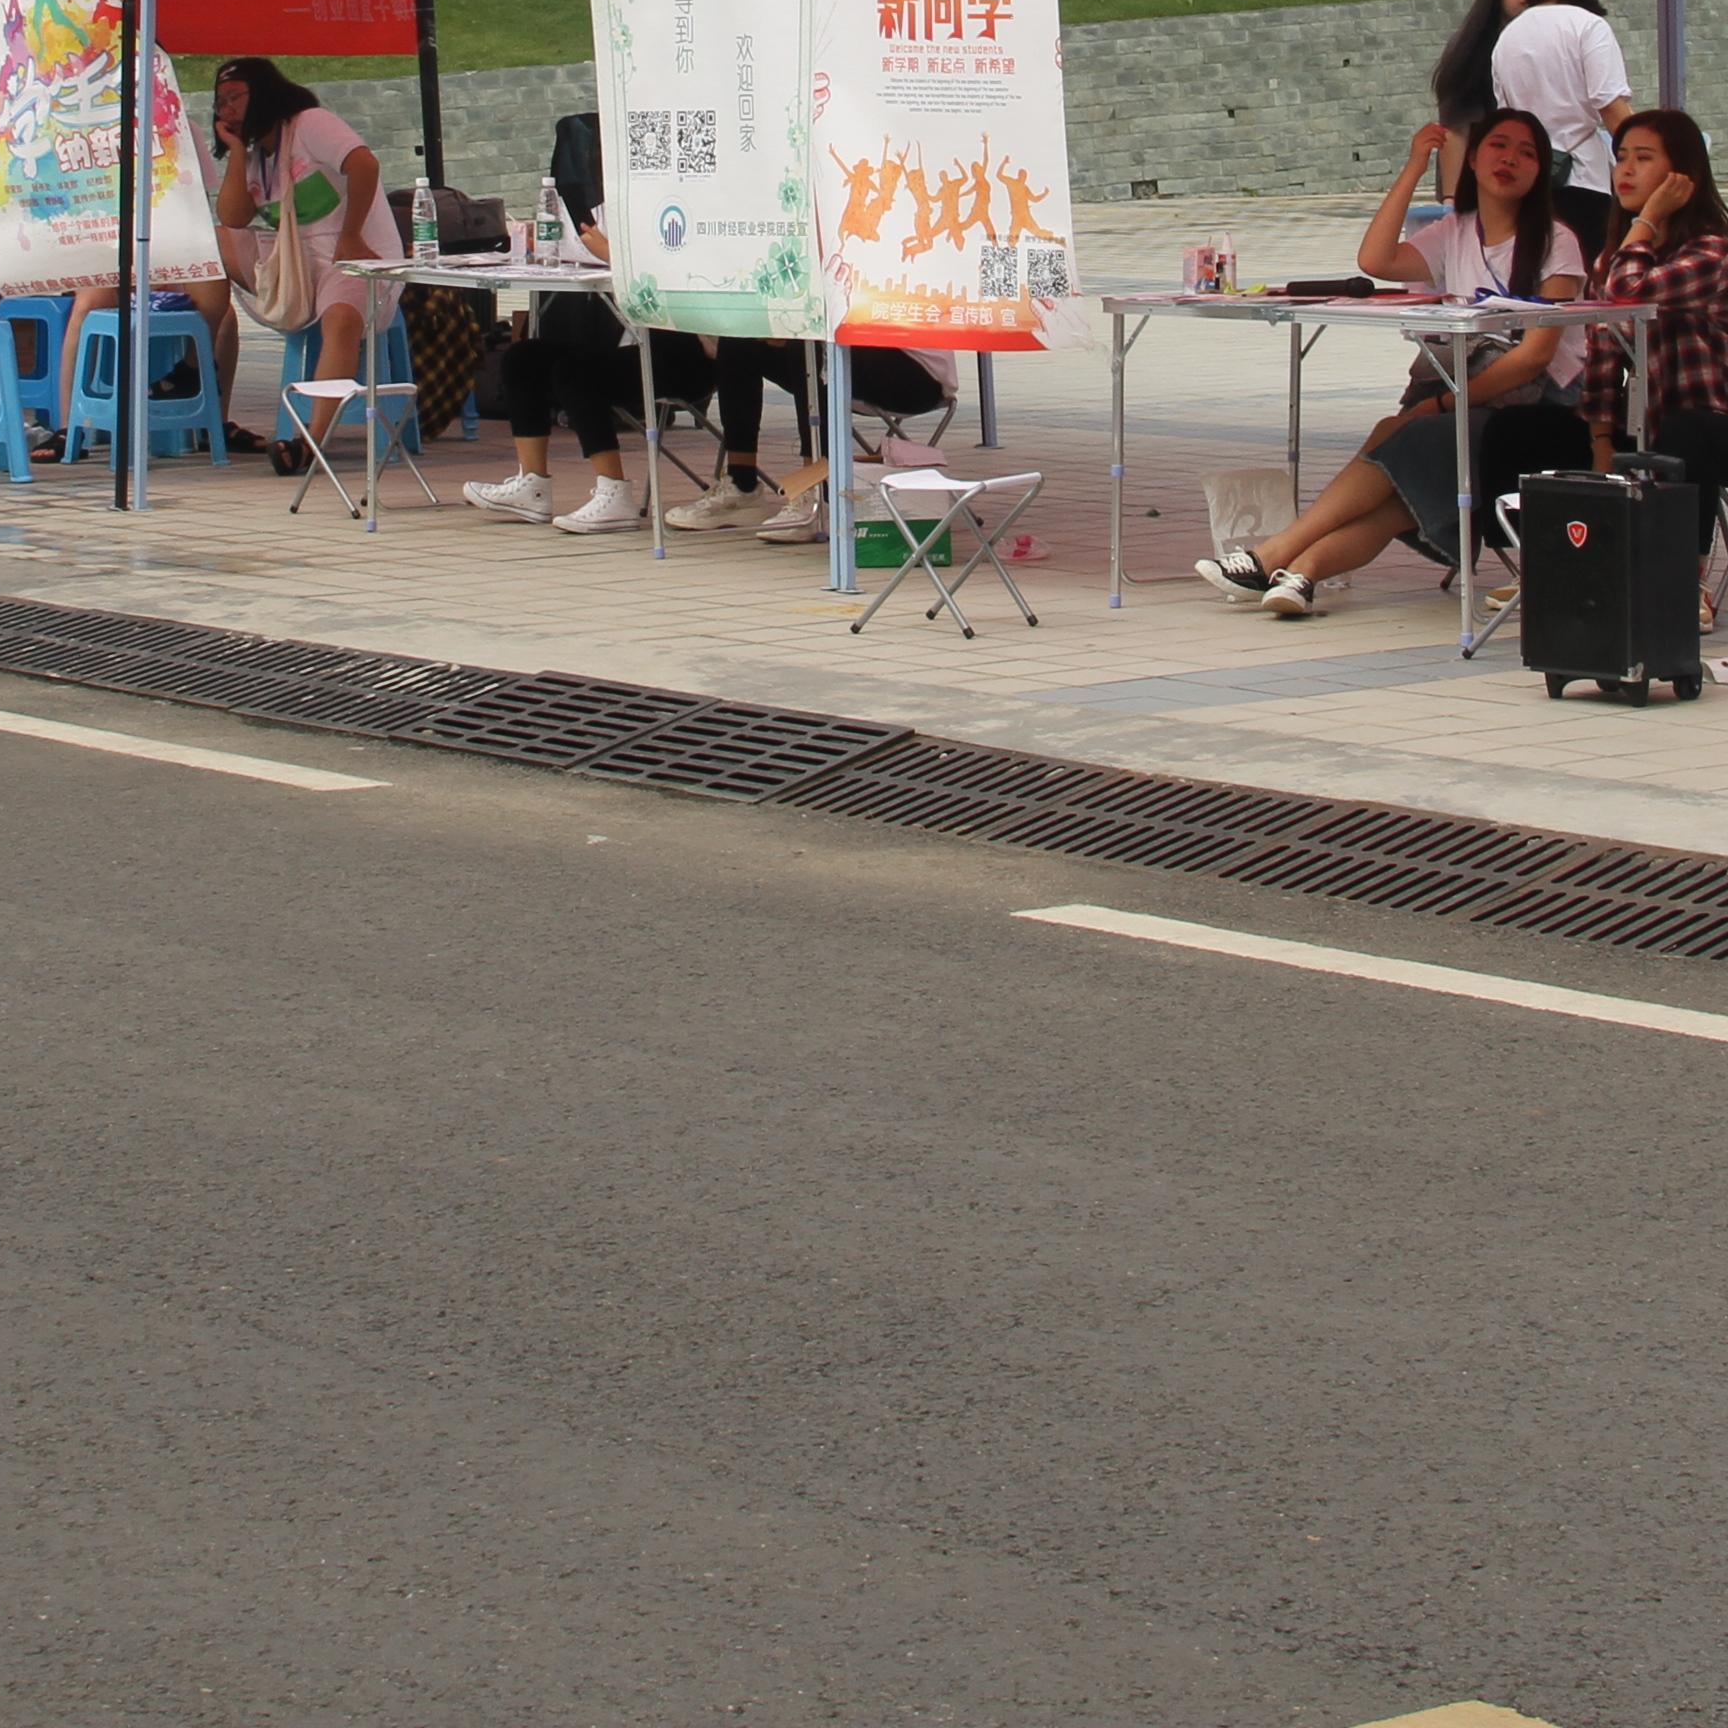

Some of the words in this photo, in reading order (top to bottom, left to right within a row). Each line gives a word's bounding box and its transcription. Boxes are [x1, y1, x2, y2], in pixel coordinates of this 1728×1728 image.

[889, 43, 925, 55] Welcome
[925, 43, 941, 55] the
[942, 45, 961, 56] new
[962, 44, 1004, 56] students
[882, 56, 920, 74] 新学期
[927, 57, 966, 74] 新起点
[974, 57, 1016, 75] 新希望
[736, 33, 757, 153] 欢迎回家
[696, 220, 809, 238] 四川财经职业学院团委宣
[1, 260, 223, 296] 会计信息管理系团学生会宣
[872, 302, 942, 324] 院学生会
[949, 305, 994, 326] 宣传部
[1000, 307, 1018, 327] 宣
